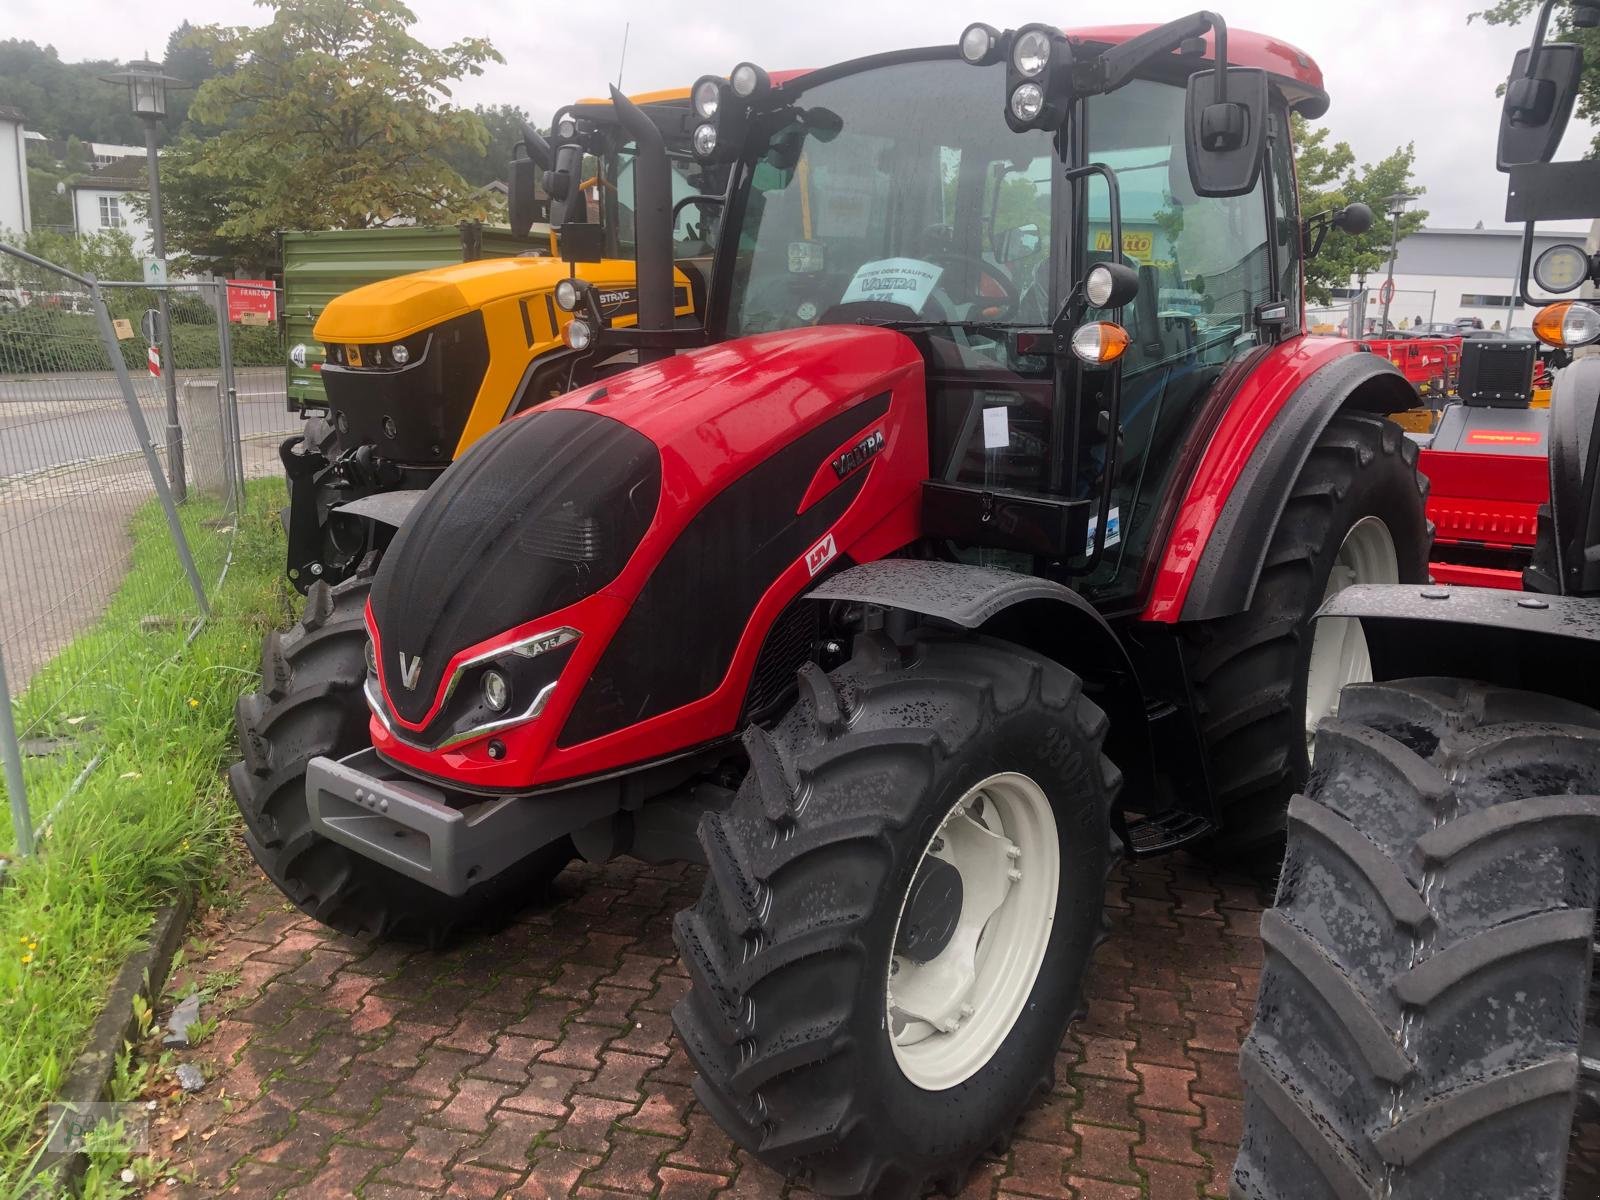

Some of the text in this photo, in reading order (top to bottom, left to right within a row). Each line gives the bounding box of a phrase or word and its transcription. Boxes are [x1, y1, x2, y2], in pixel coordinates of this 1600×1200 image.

[1096, 232, 1151, 251] Ntto
[862, 277, 917, 292] VALTRA
[600, 291, 630, 304] STRAC
[532, 637, 558, 654] A75
